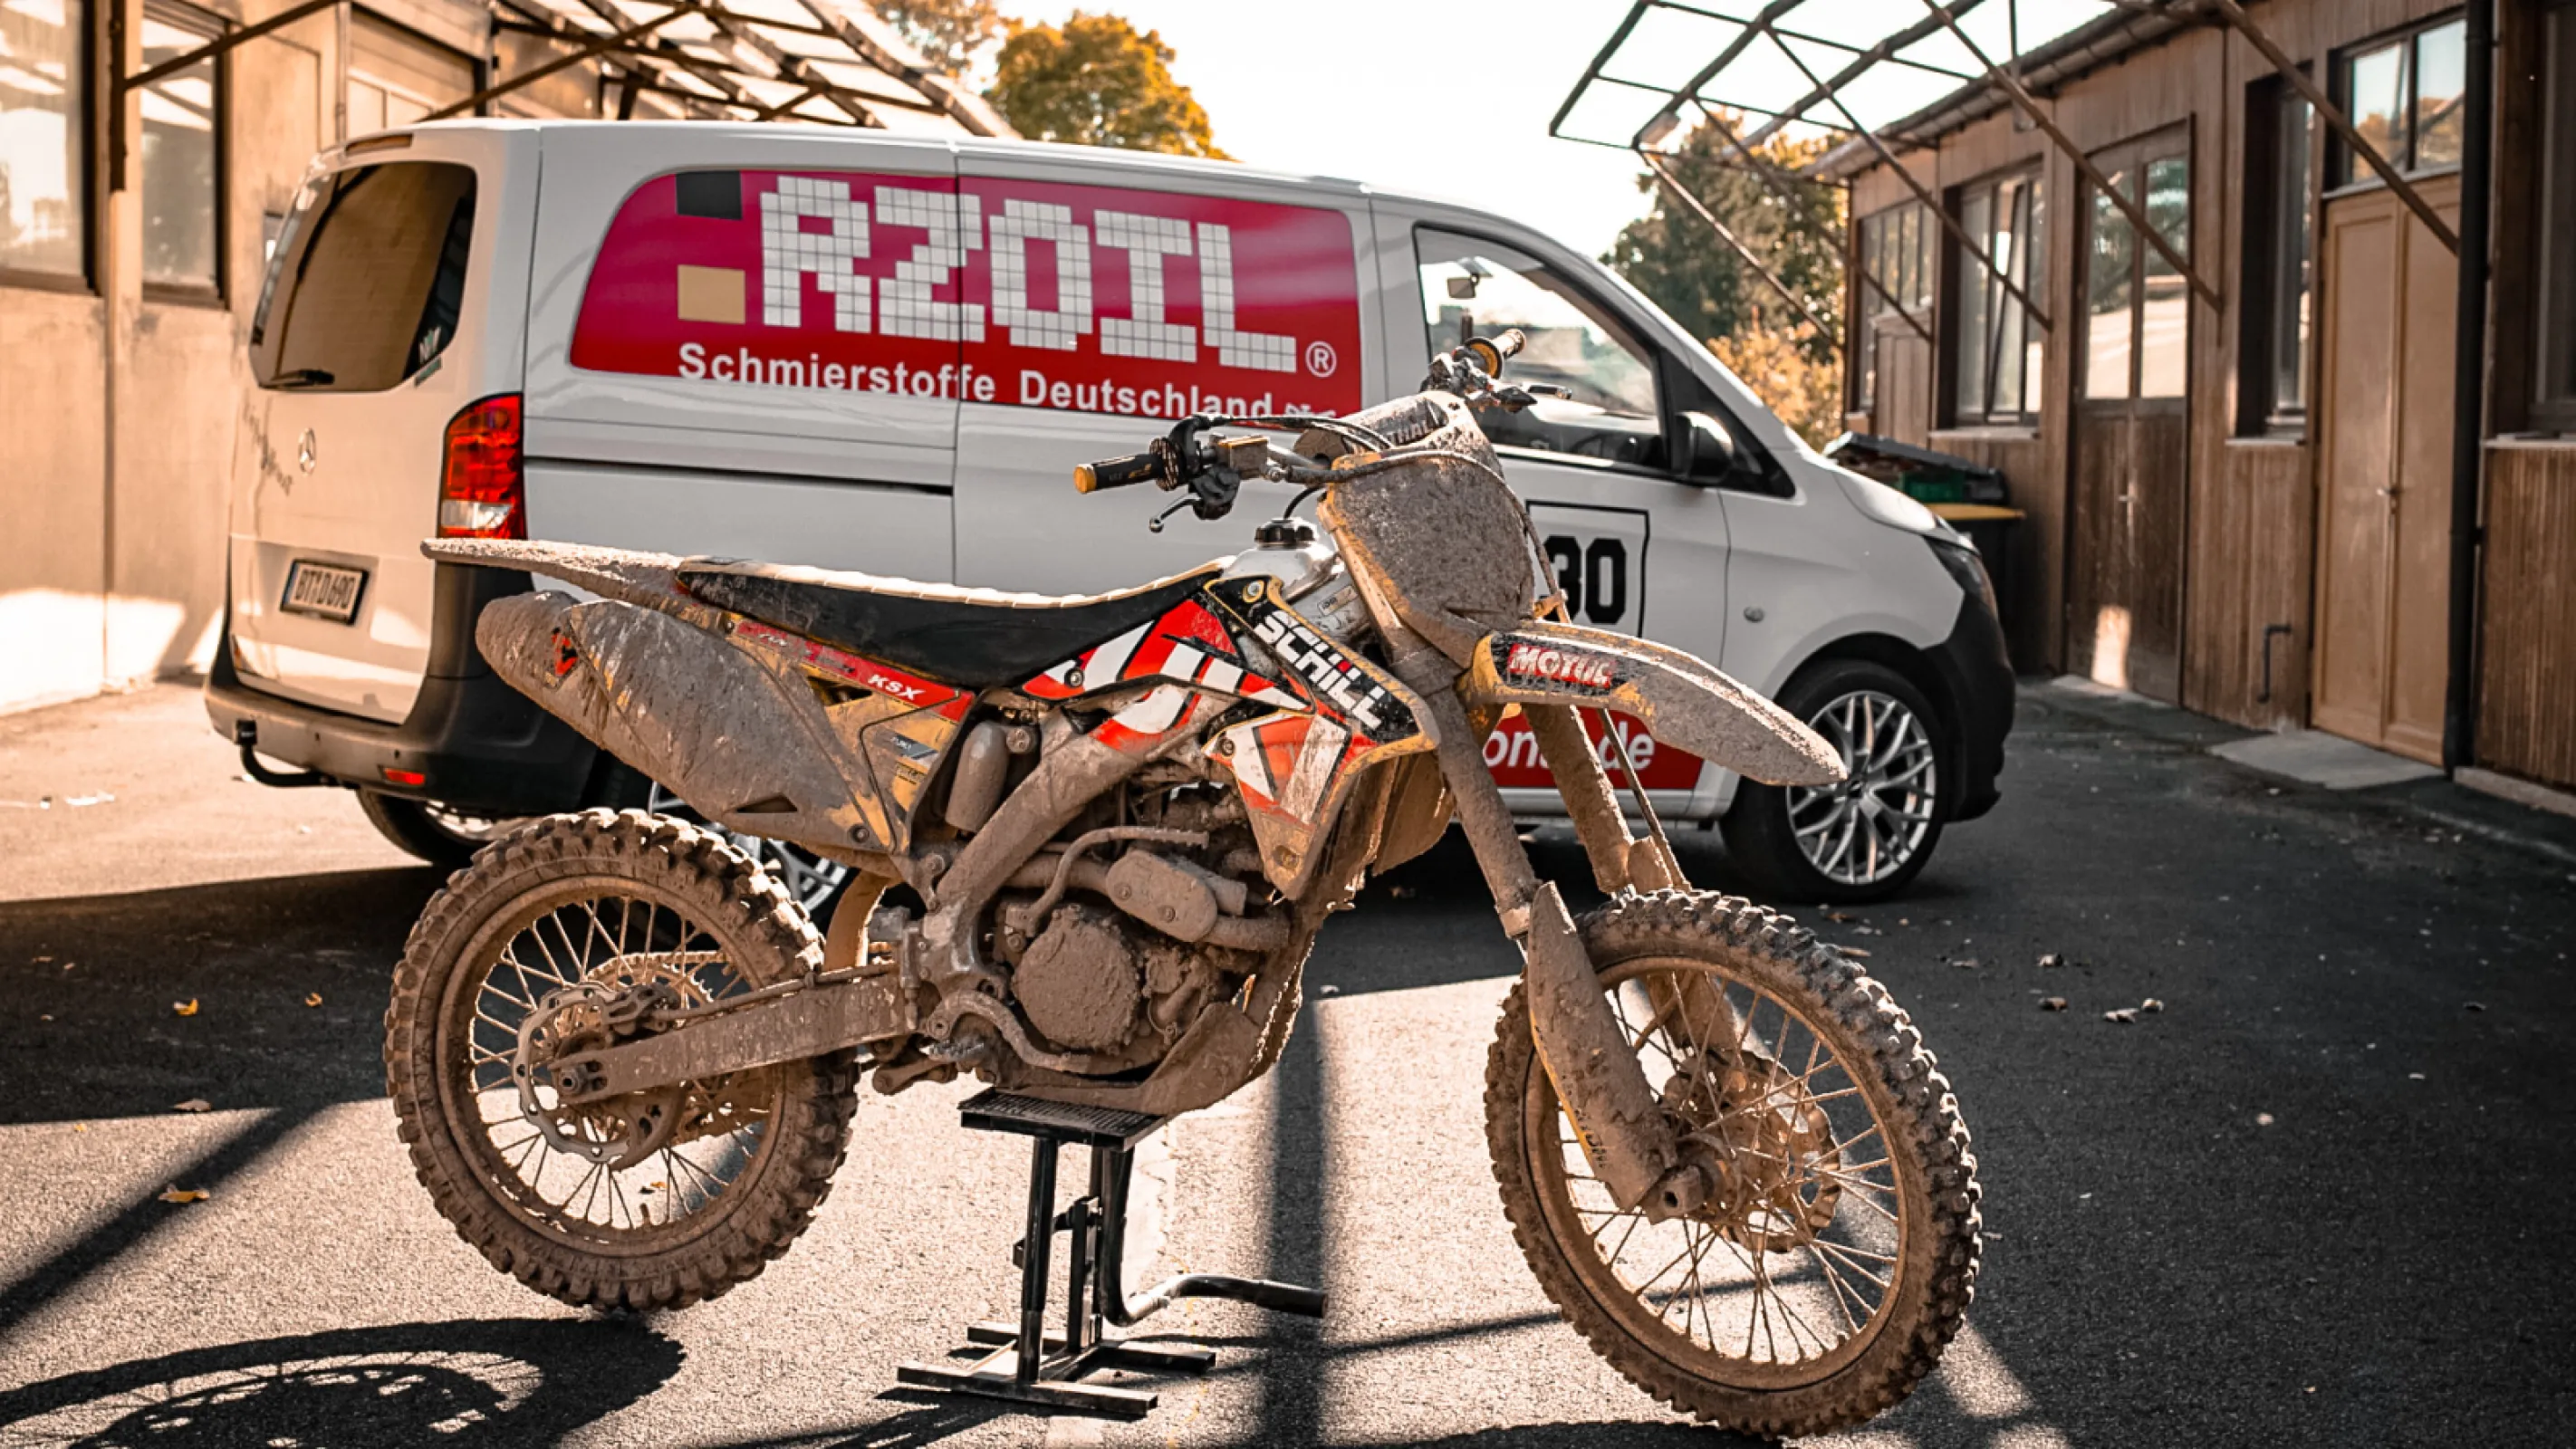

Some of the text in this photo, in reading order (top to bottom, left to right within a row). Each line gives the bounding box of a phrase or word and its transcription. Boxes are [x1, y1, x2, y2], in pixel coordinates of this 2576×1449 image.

[760, 175, 1297, 373] RZOIL
[678, 342, 1273, 418] Schmierstoffe Deutschland
[867, 673, 927, 702] KSX
[1509, 646, 1610, 686] MOTUL
